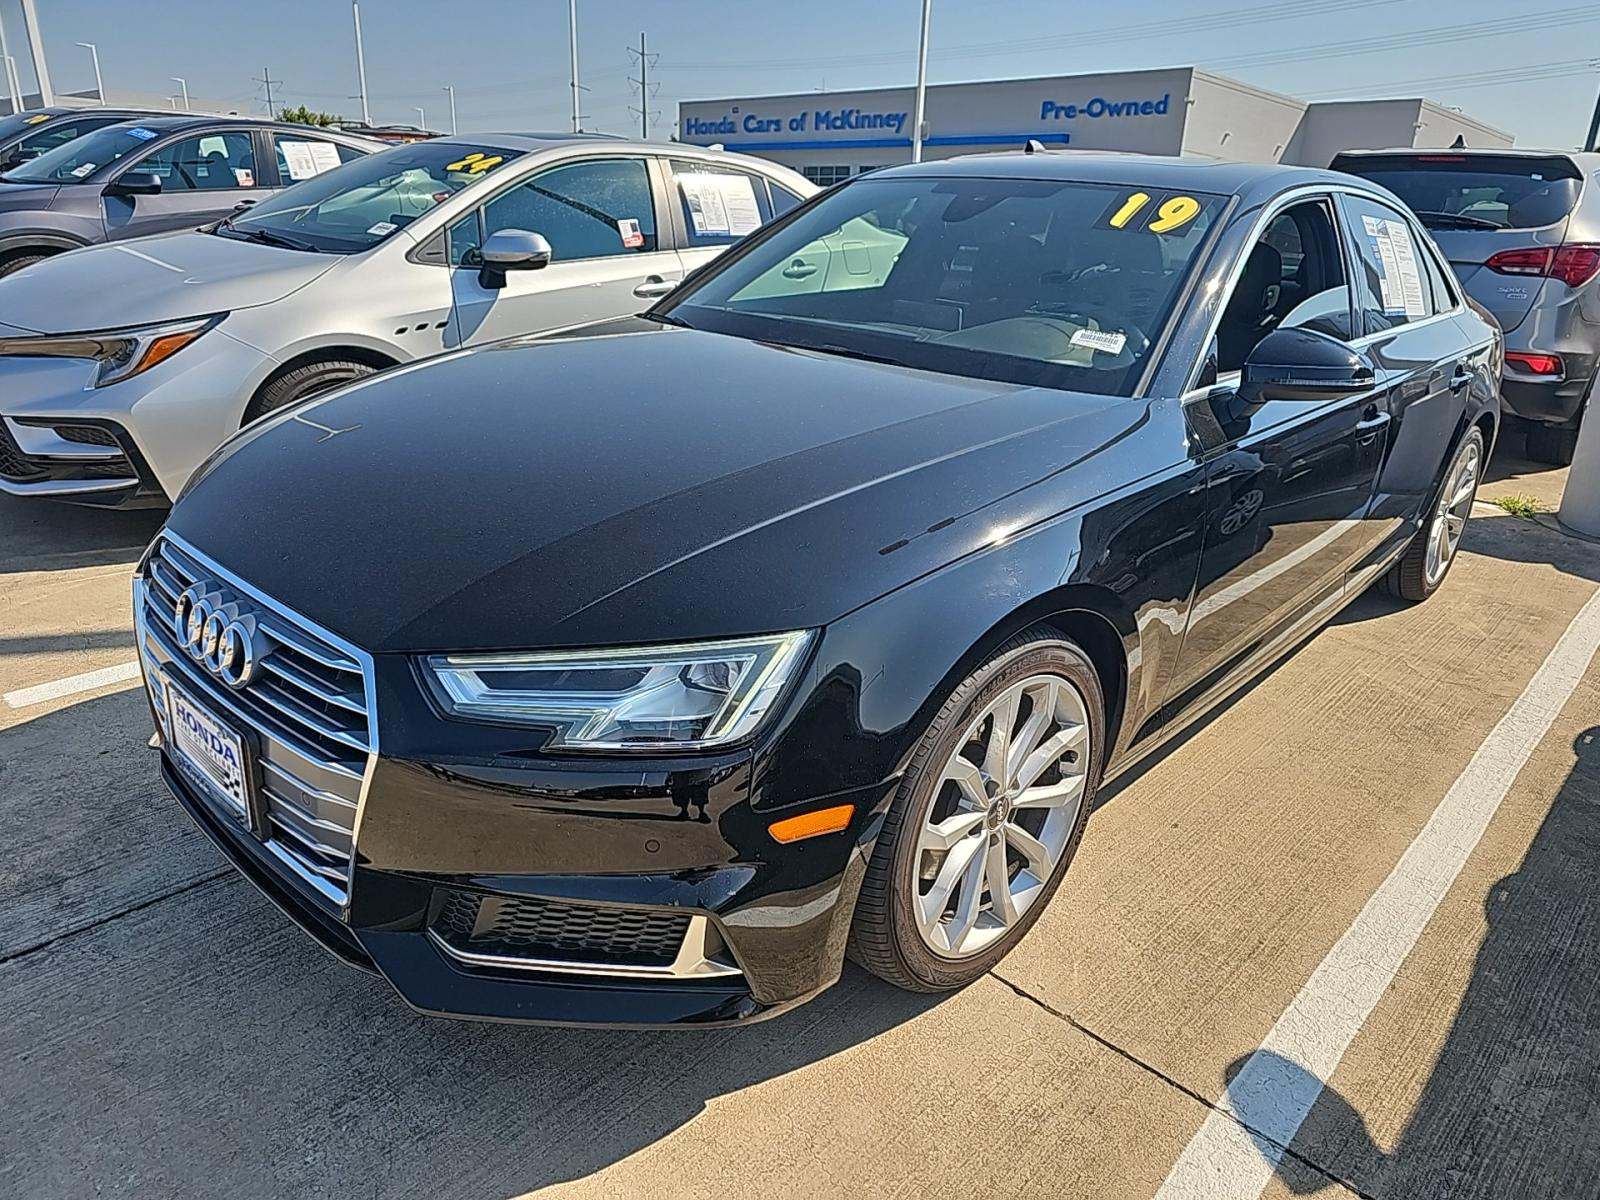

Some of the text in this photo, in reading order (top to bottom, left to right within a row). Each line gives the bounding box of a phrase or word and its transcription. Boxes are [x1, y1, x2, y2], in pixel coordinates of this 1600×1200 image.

[686, 108, 908, 136] Honda Cars of McKinney
[1041, 94, 1170, 119] Pre-Owned
[1109, 192, 1201, 233] 19
[175, 702, 238, 768] HONDA
